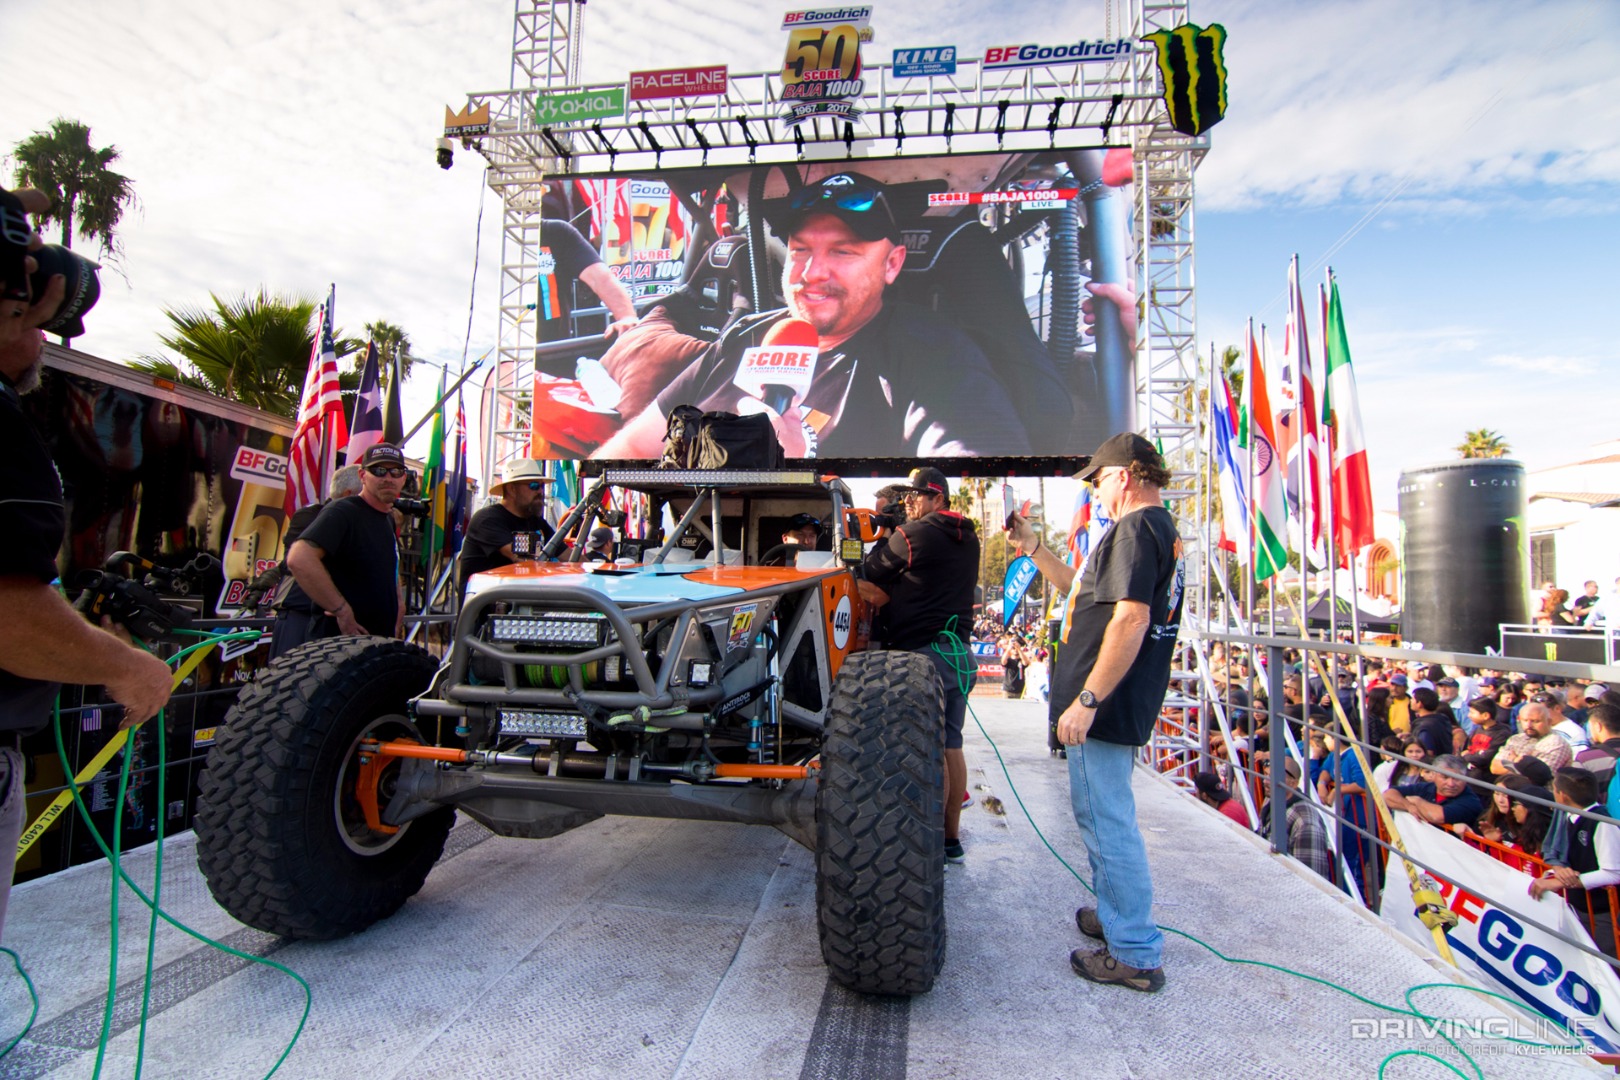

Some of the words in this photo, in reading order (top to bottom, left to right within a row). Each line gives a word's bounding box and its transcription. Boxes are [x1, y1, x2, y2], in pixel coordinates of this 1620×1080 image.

[784, 8, 869, 22] BFGoodrich
[781, 25, 859, 84] 50
[895, 48, 954, 64] KING
[984, 40, 1132, 63] BFGoodrich
[632, 70, 725, 89] RACELINE
[803, 69, 840, 81] SCORE
[684, 83, 725, 92] WHEELS
[783, 83, 822, 98] BAJA
[825, 80, 861, 96] 1000
[794, 104, 818, 116] 1967
[826, 103, 850, 113] 2017
[929, 193, 969, 202] SCORE
[981, 190, 1059, 203] #BAJA1000
[655, 261, 683, 278] 100
[747, 352, 811, 367] SCORE
[237, 450, 287, 475] BFGo
[835, 612, 850, 632] 4454
[40, 804, 63, 822] WLL
[20, 824, 44, 845] 6400
